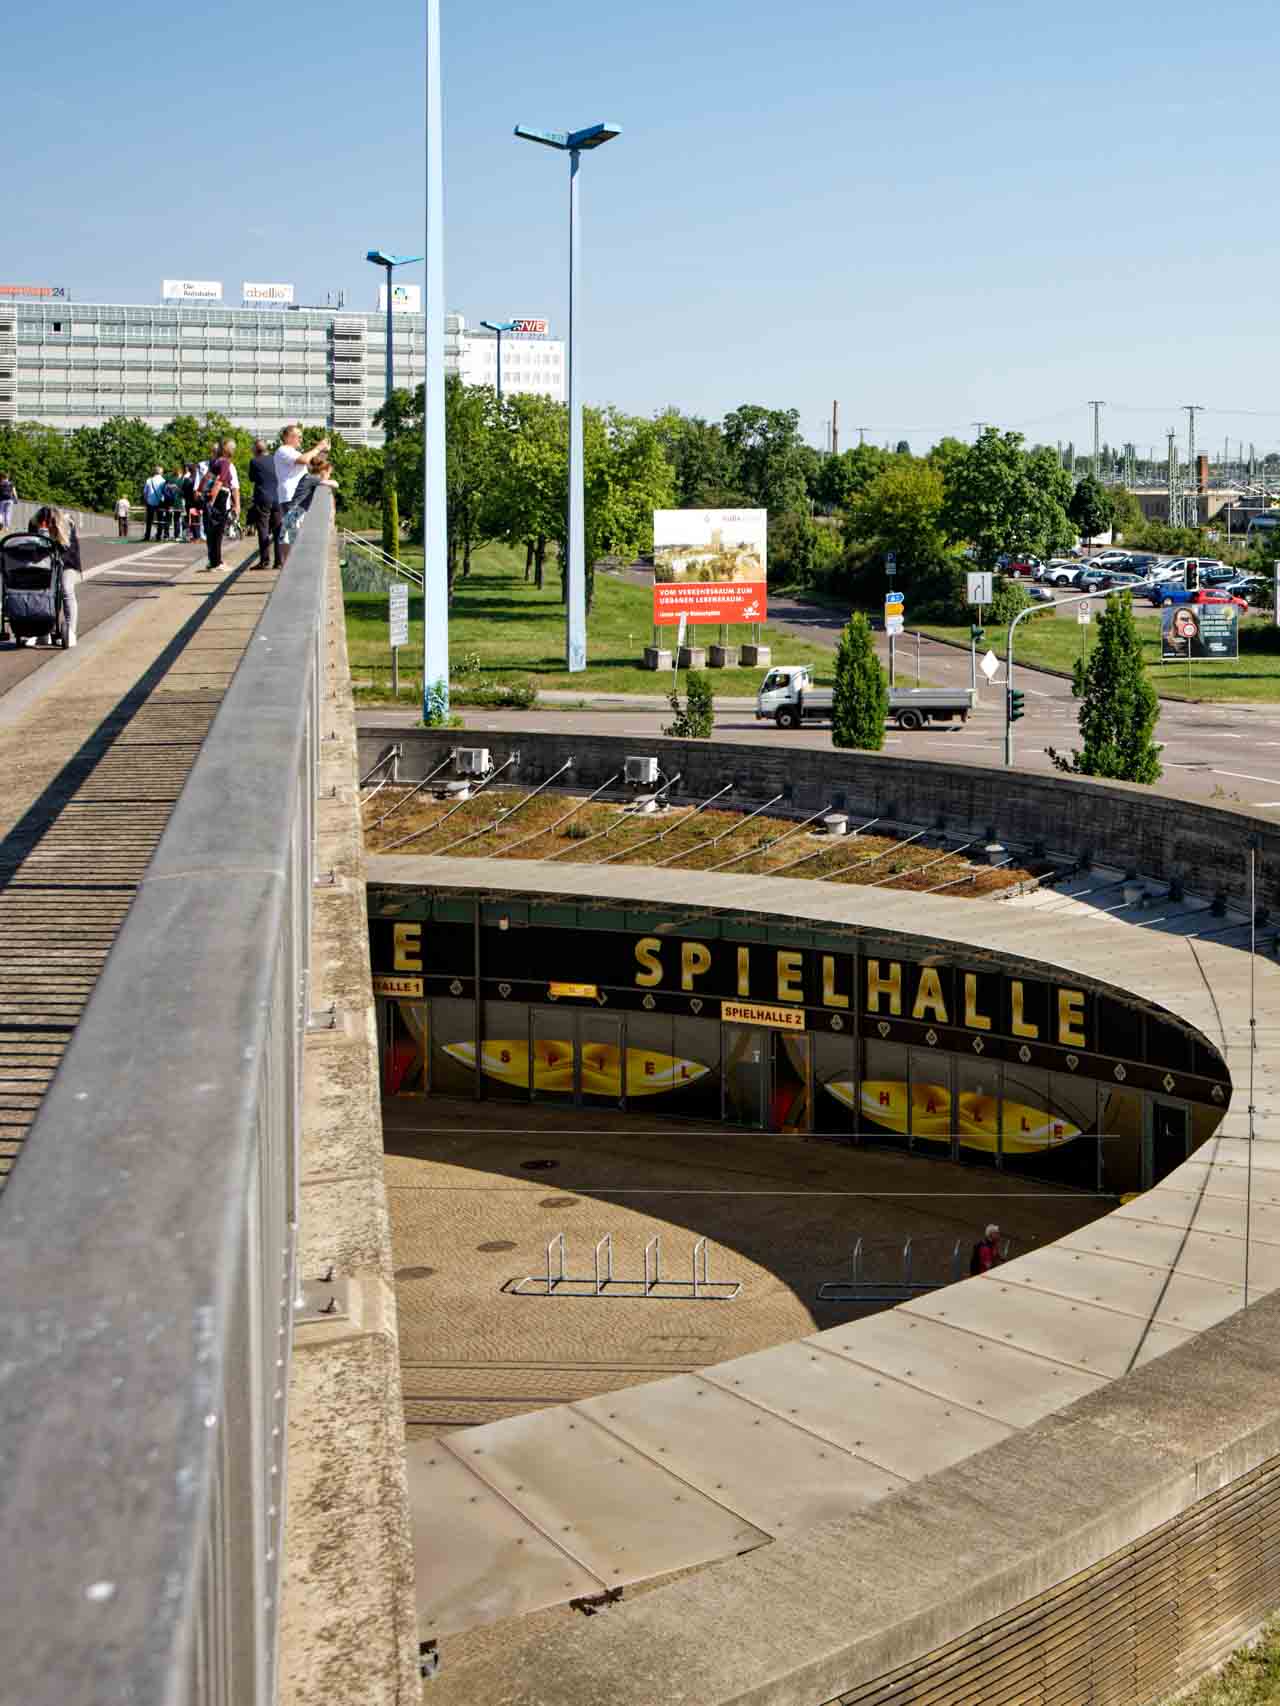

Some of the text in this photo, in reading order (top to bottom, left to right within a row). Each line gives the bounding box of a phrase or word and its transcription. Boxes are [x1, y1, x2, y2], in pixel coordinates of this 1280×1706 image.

[634, 937, 1086, 1048] SPIELHALLE
[725, 1006, 802, 1025] SPIELHALLE 2
